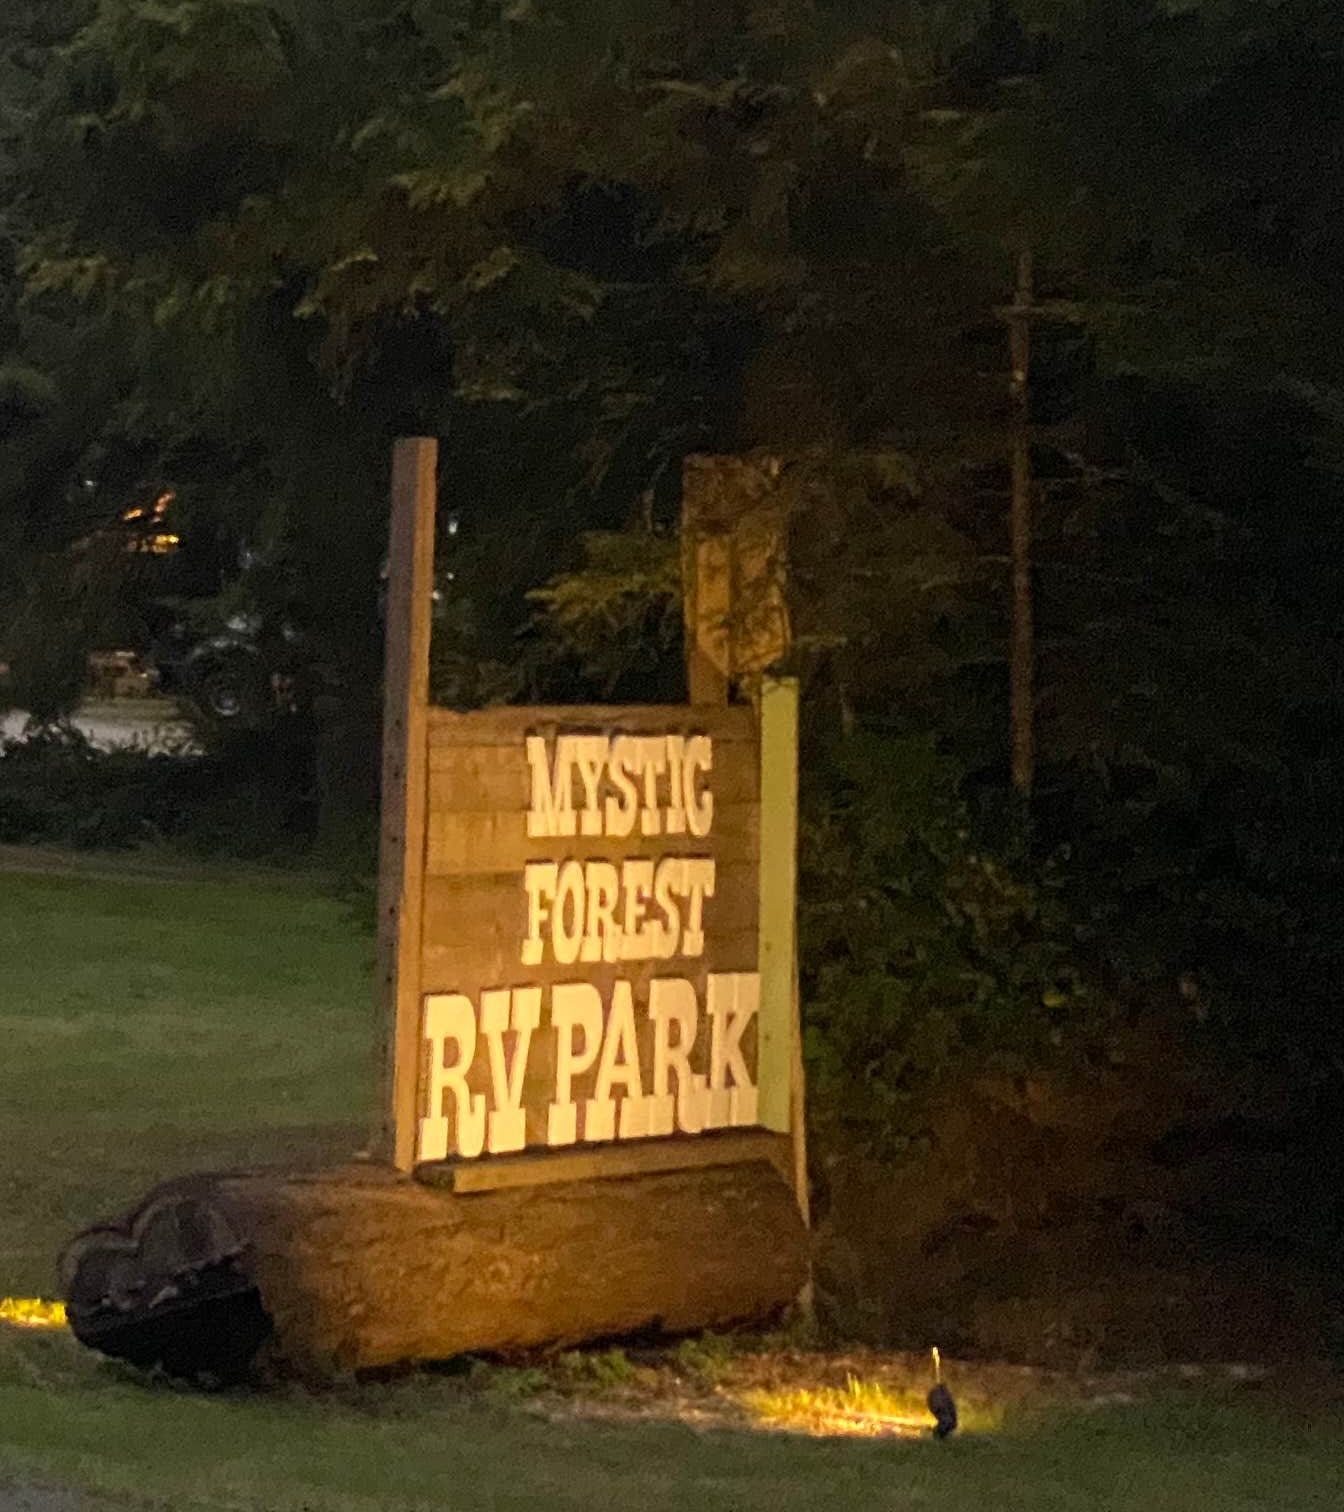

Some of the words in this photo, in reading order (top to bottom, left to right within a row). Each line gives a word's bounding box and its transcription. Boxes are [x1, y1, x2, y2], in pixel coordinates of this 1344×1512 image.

[526, 734, 712, 838] MYSTIC
[521, 858, 714, 965] FOREST
[417, 986, 542, 1161] RV
[546, 972, 760, 1146] PARK
